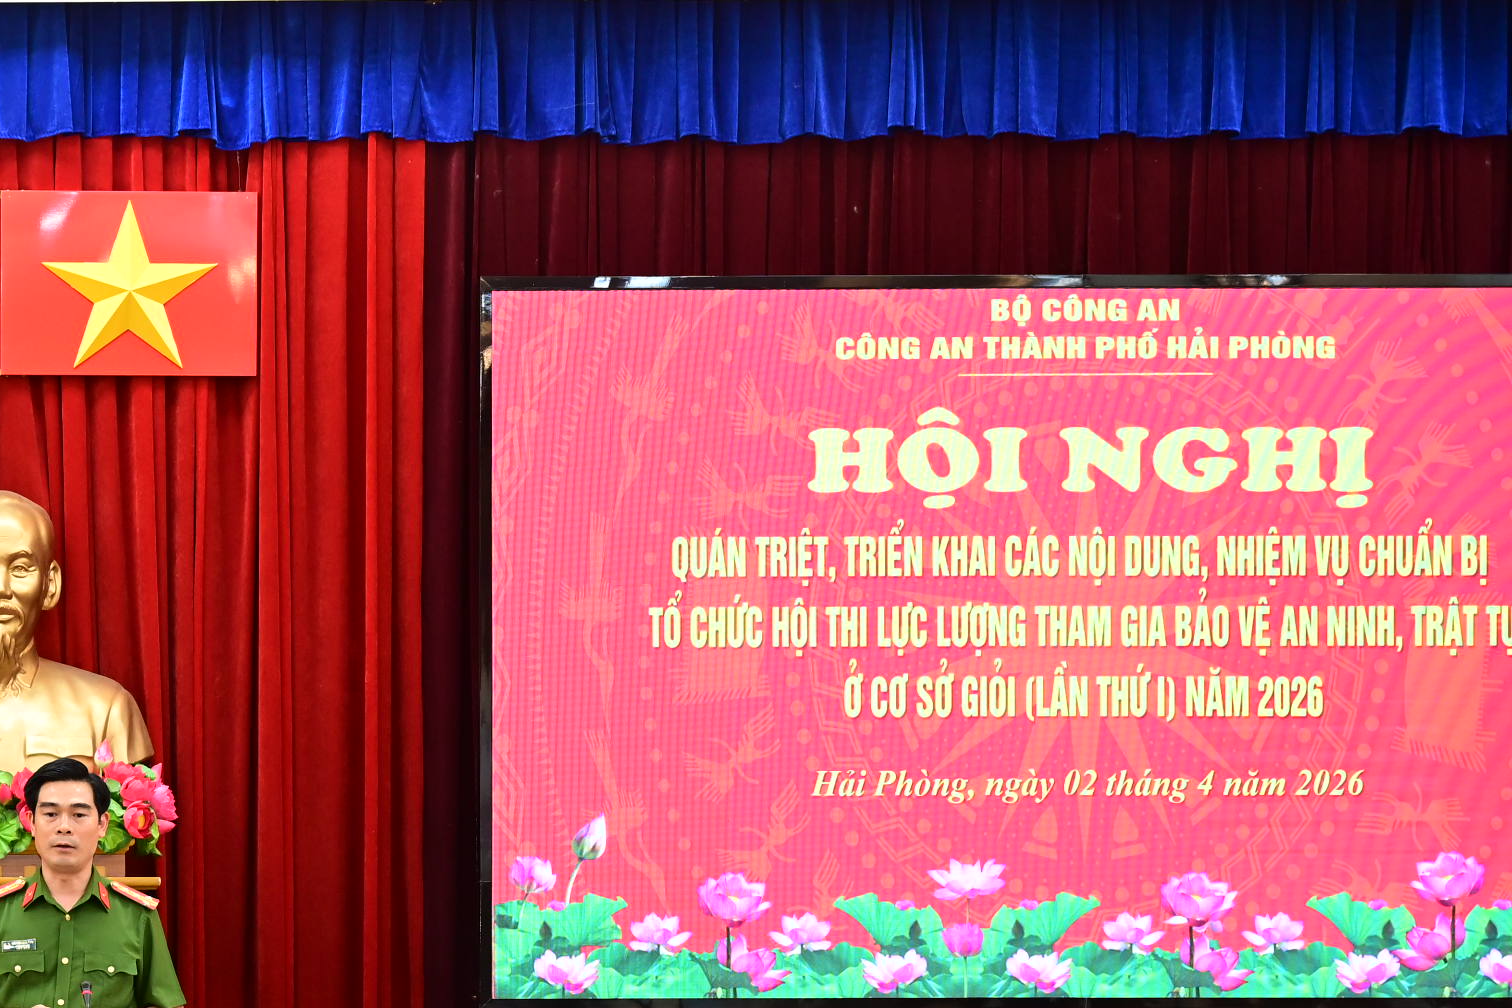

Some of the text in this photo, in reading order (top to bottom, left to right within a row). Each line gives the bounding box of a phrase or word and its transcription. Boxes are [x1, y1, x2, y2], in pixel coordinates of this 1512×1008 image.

[990, 293, 1180, 326] BỘ CÔNG AN
[835, 327, 1336, 360] CÔNG AN THÀNH PHỐ HẢI PHÒNG
[808, 407, 1374, 510] HỘI NGHỊ
[672, 518, 1488, 586] QUÁN TRIỆT, TRIỂN KHAI CÁC NỘI DUNG, NHIỆM VỤ CHUẨN BỊ
[649, 590, 683, 649] TỔ
[690, 594, 763, 649] CHỨC
[772, 598, 817, 657] HỘI
[826, 607, 868, 648] THI
[878, 602, 928, 657] LỰC
[937, 602, 1026, 656] LƯỢNG
[1034, 606, 1112, 647] THAM
[1121, 605, 1167, 648] GIA
[1175, 588, 1230, 647] BẢO
[1238, 597, 1271, 656] VỆ
[1280, 606, 1318, 647] AN
[1327, 606, 1403, 652] NINH,
[1411, 597, 1478, 656] TRẬT
[844, 658, 1324, 721] Ở CƠ SỞ GIỎI (LẦN THỨ I) NĂM 2026
[811, 769, 1364, 804] Hải Phòng, ngày 02 tháng 4 năm 2026
